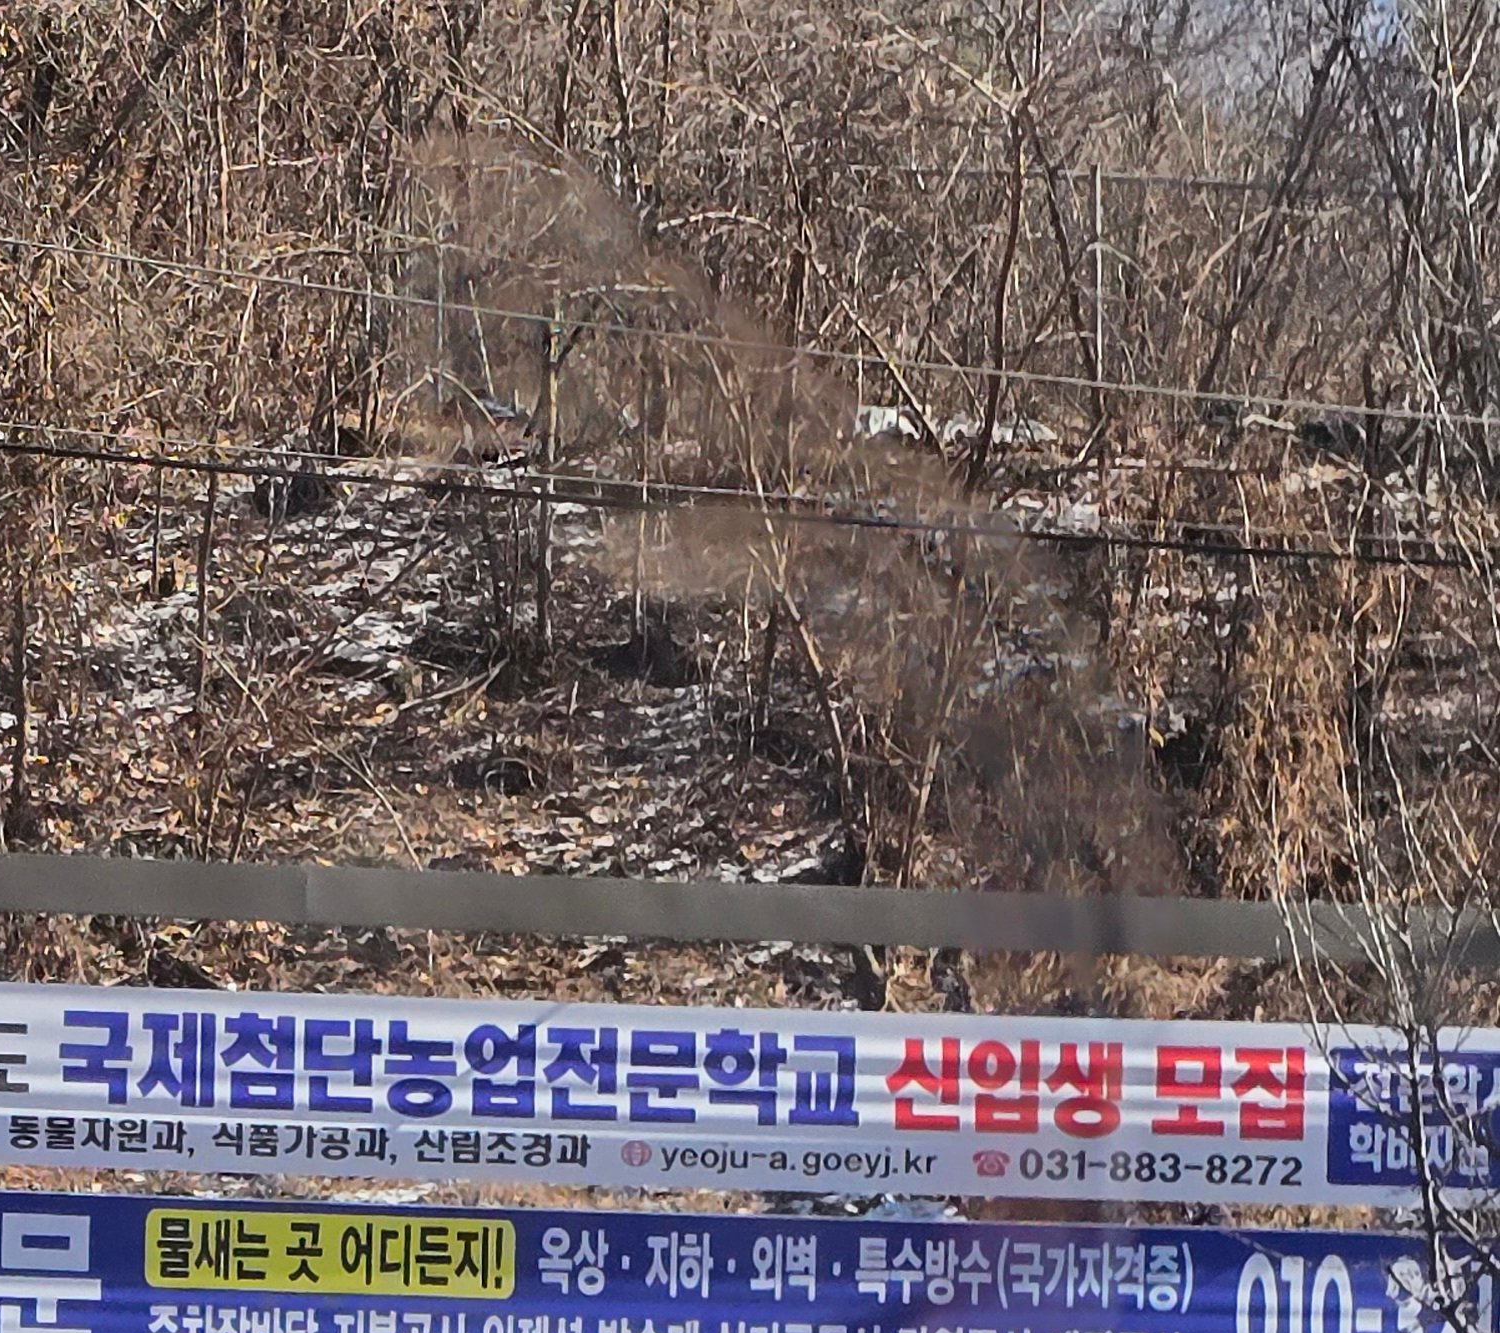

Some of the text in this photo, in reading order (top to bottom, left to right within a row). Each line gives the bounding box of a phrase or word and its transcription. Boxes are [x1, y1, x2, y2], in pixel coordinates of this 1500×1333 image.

[60, 1009, 859, 1127] 국제첨단농업전문학교
[886, 1037, 1124, 1138] 신입생
[1150, 1045, 1307, 1141] 모집
[8, 1115, 196, 1158] 동물자원과,
[211, 1122, 398, 1164] 식품가공과,
[414, 1130, 591, 1168] 산림조경과
[660, 1140, 938, 1180] yeoju-a.goeyj.kr
[1019, 1148, 1303, 1187] 031-883-8272
[156, 1218, 504, 1290] 물새는 곳 어디든지!
[538, 1227, 608, 1297] 옥상
[646, 1231, 713, 1298] 지하
[750, 1235, 817, 1303] 외벽
